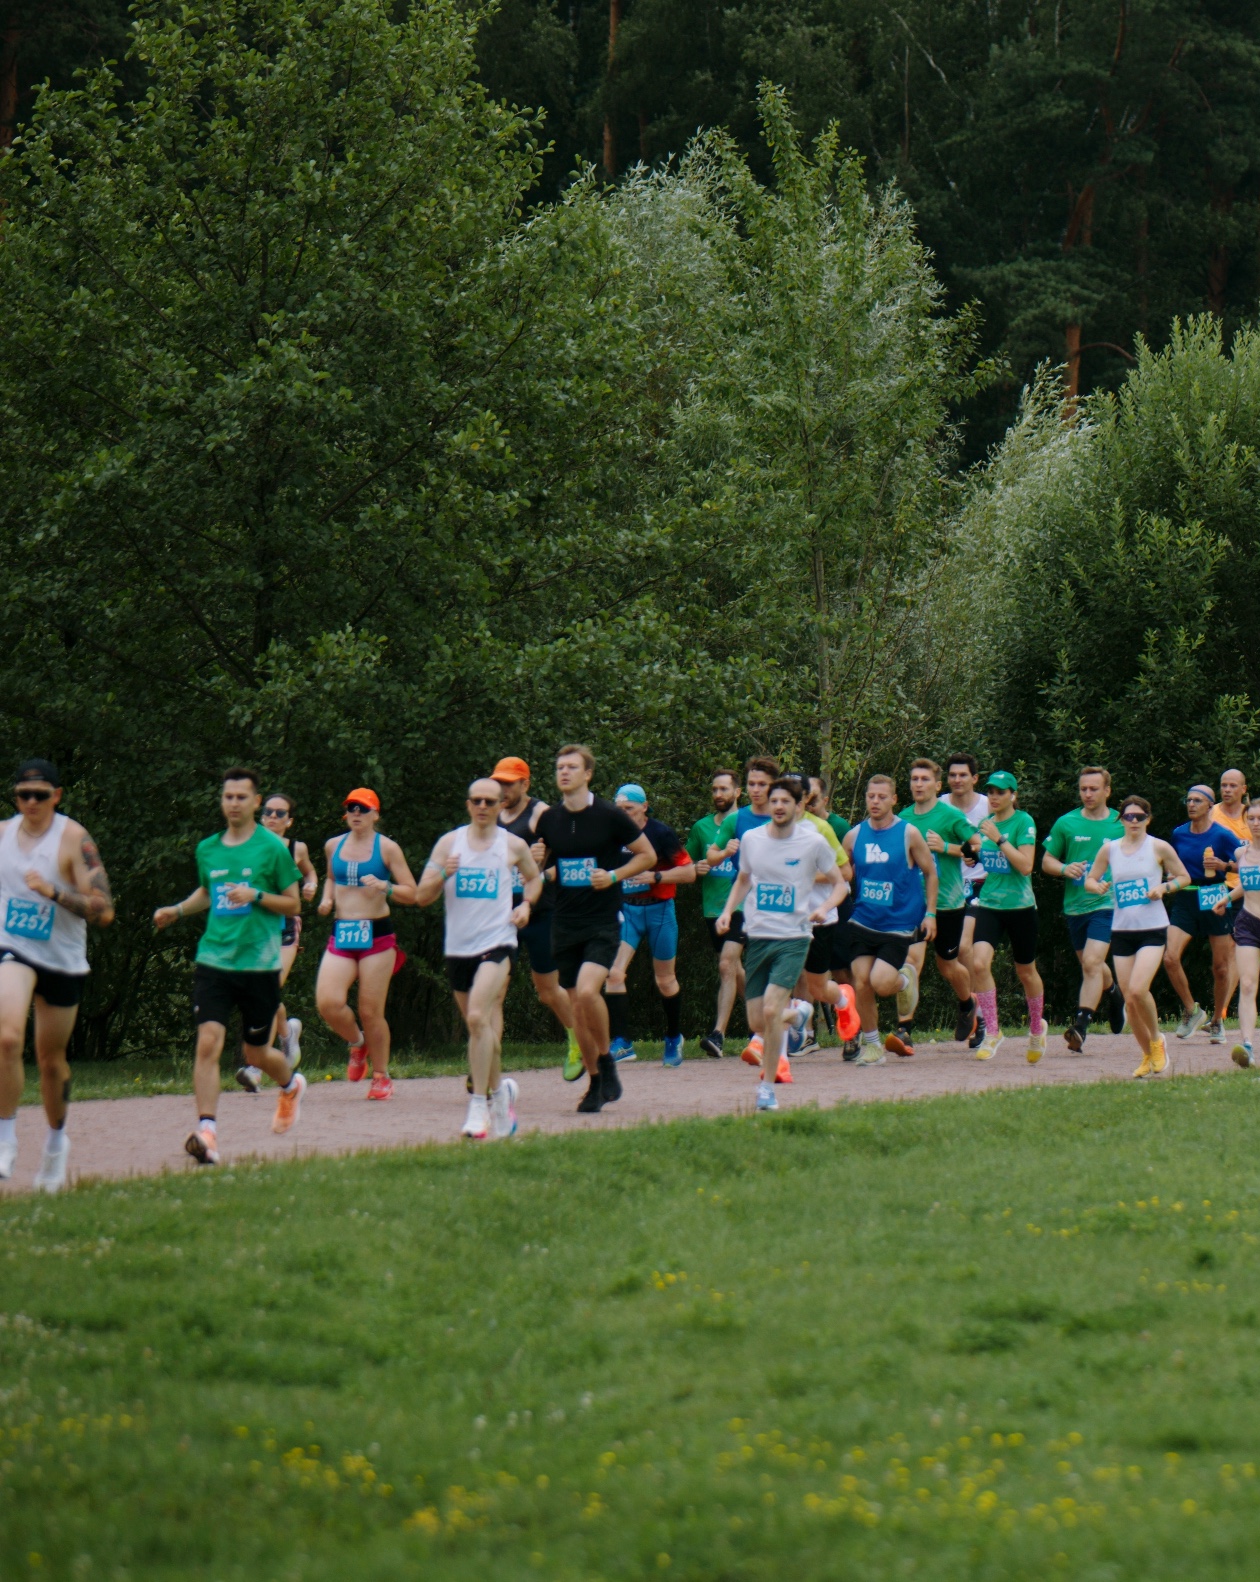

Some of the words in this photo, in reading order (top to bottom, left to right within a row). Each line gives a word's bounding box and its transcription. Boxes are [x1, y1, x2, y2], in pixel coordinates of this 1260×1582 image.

[586, 859, 593, 867] A
[984, 857, 1008, 869] 2703
[488, 870, 496, 878] A
[459, 878, 496, 892] 3578
[784, 886, 791, 894] A
[759, 893, 792, 907] 2149
[863, 887, 890, 901] 3691
[1119, 887, 1147, 903] 2563
[1202, 893, 1227, 906] 200
[7, 910, 50, 930] 2257
[362, 921, 369, 929] A
[338, 930, 370, 942] 3119
